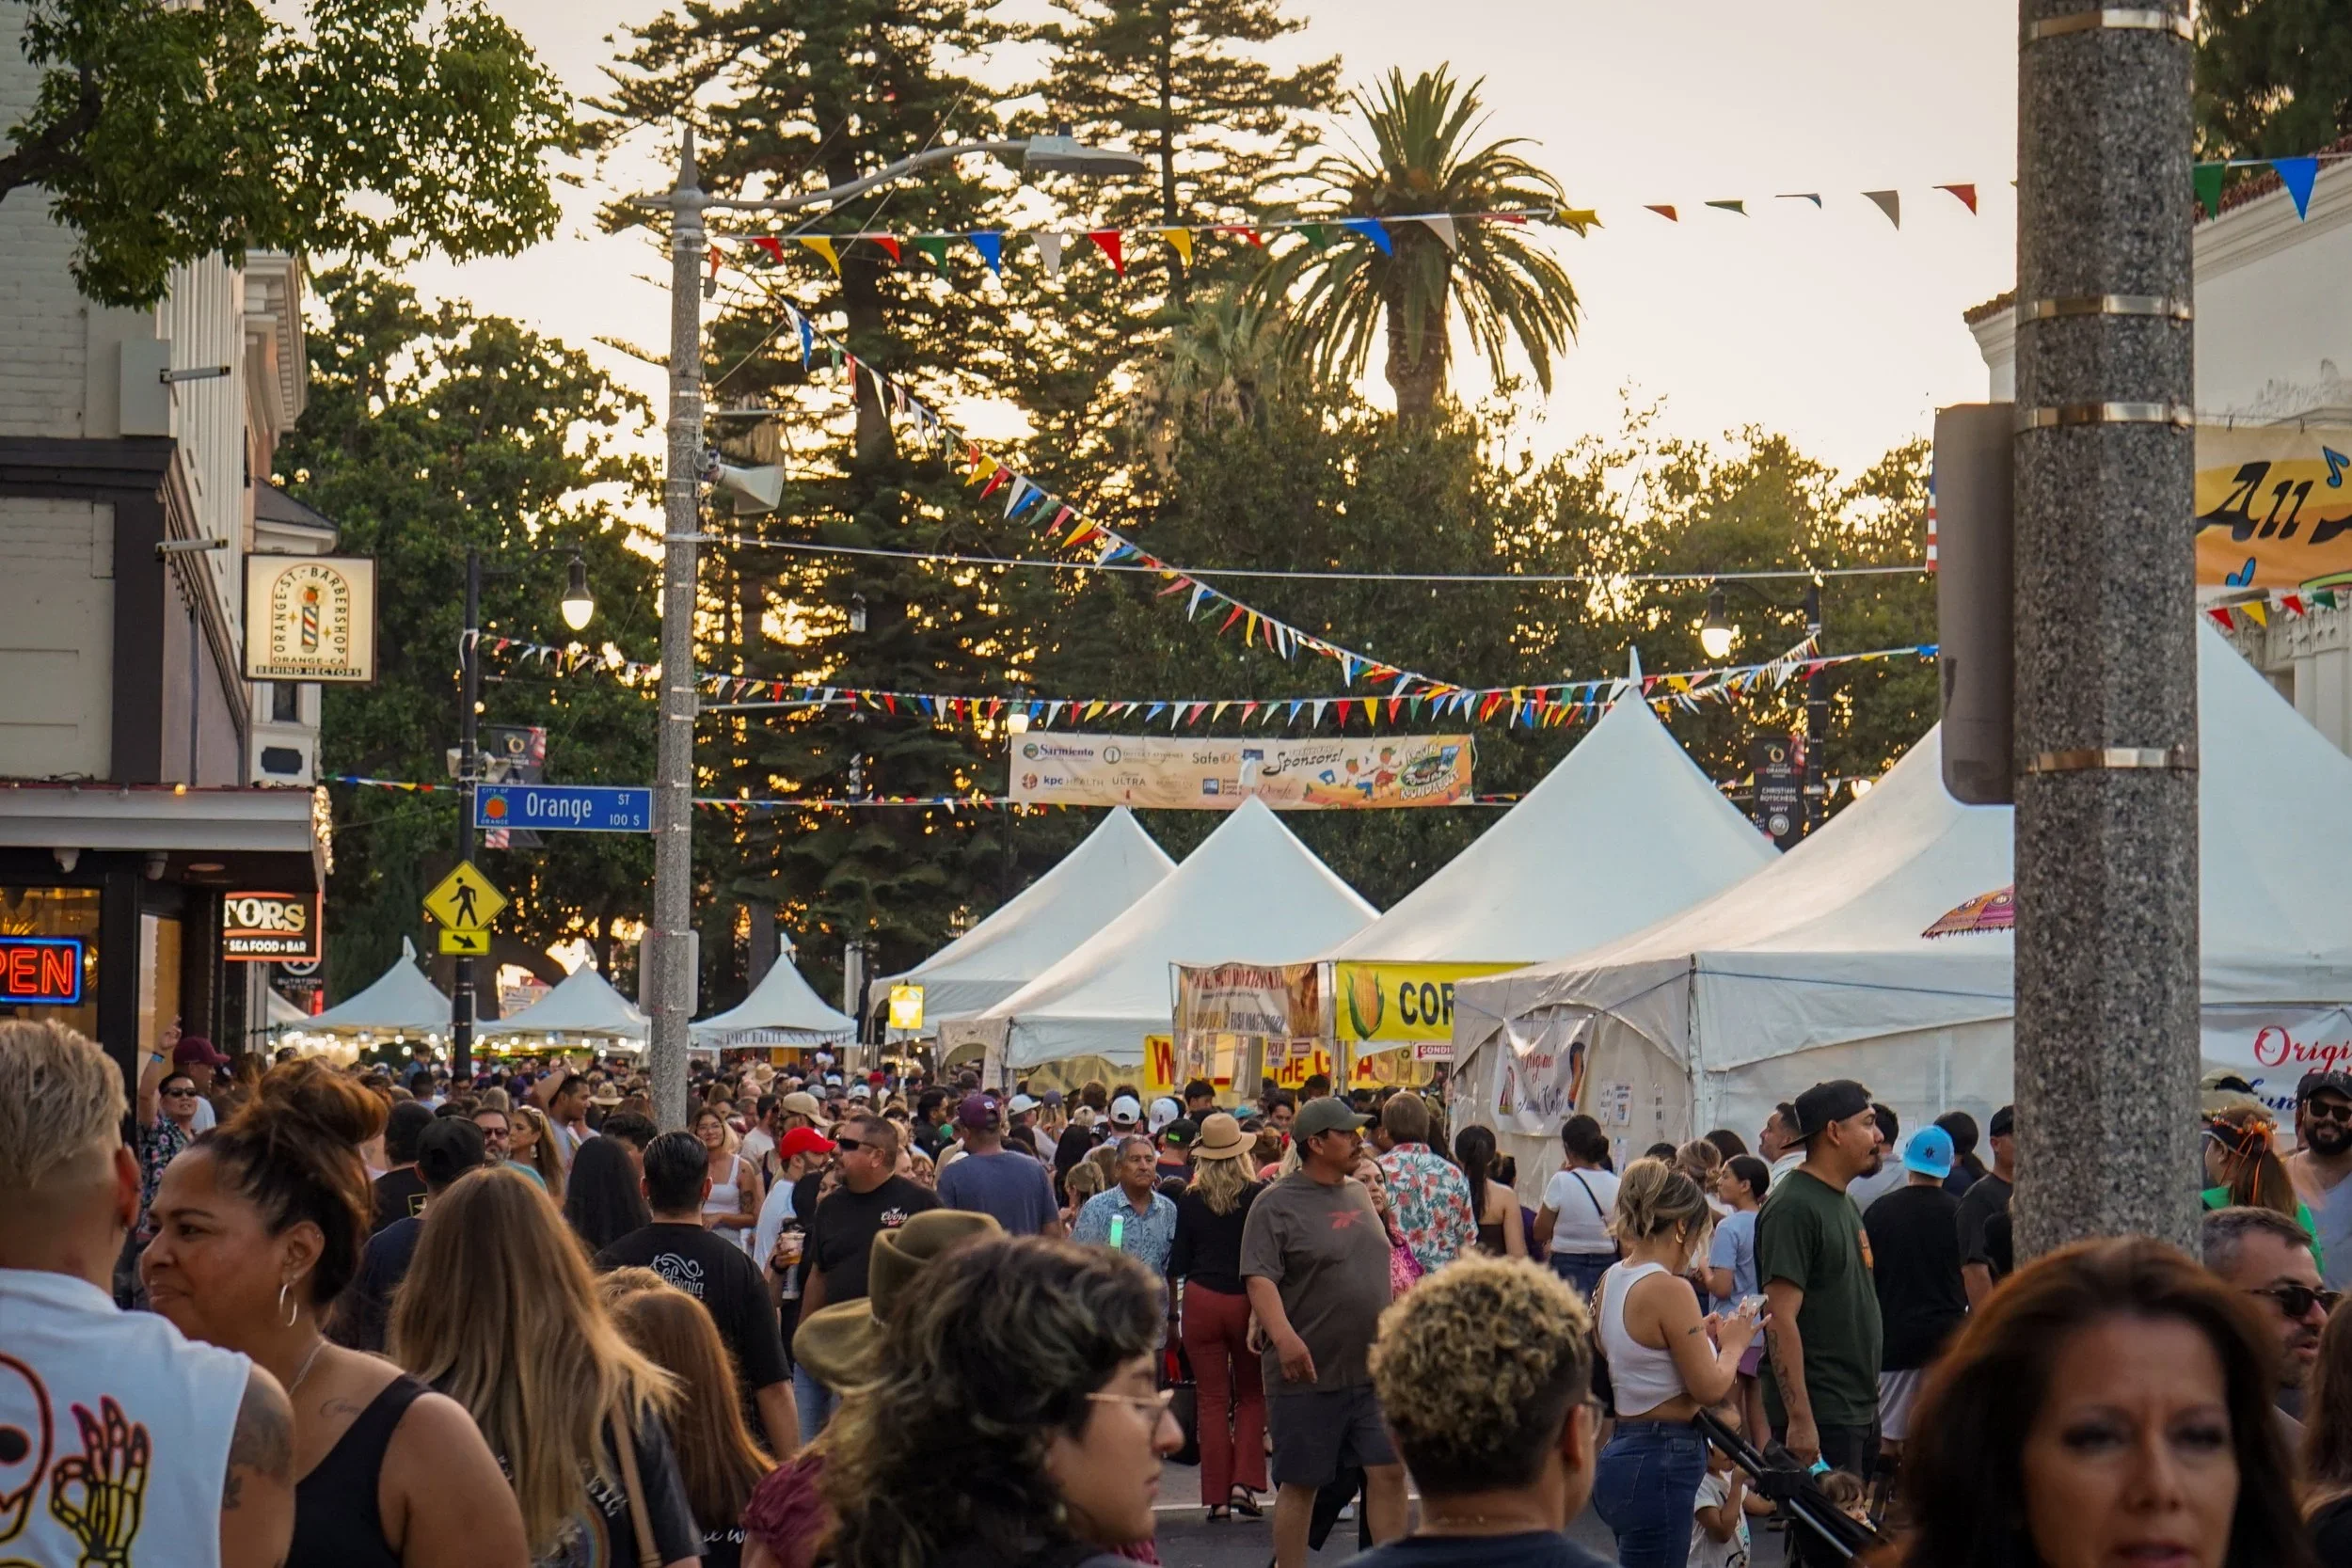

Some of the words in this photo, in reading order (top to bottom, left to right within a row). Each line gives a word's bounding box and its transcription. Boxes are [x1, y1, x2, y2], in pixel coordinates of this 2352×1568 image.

[2196, 461, 2314, 543] All
[1040, 744, 1094, 756] Sarmiento
[1262, 749, 1343, 776] Sponsors!
[1043, 775, 1064, 785] kpc
[1112, 777, 1146, 786] ULTRA
[618, 794, 630, 806] ST
[526, 792, 593, 825] Orange
[610, 814, 628, 827] 100
[633, 815, 641, 827] S
[286, 942, 307, 952] BAR
[881, 1211, 908, 1221] Coors
